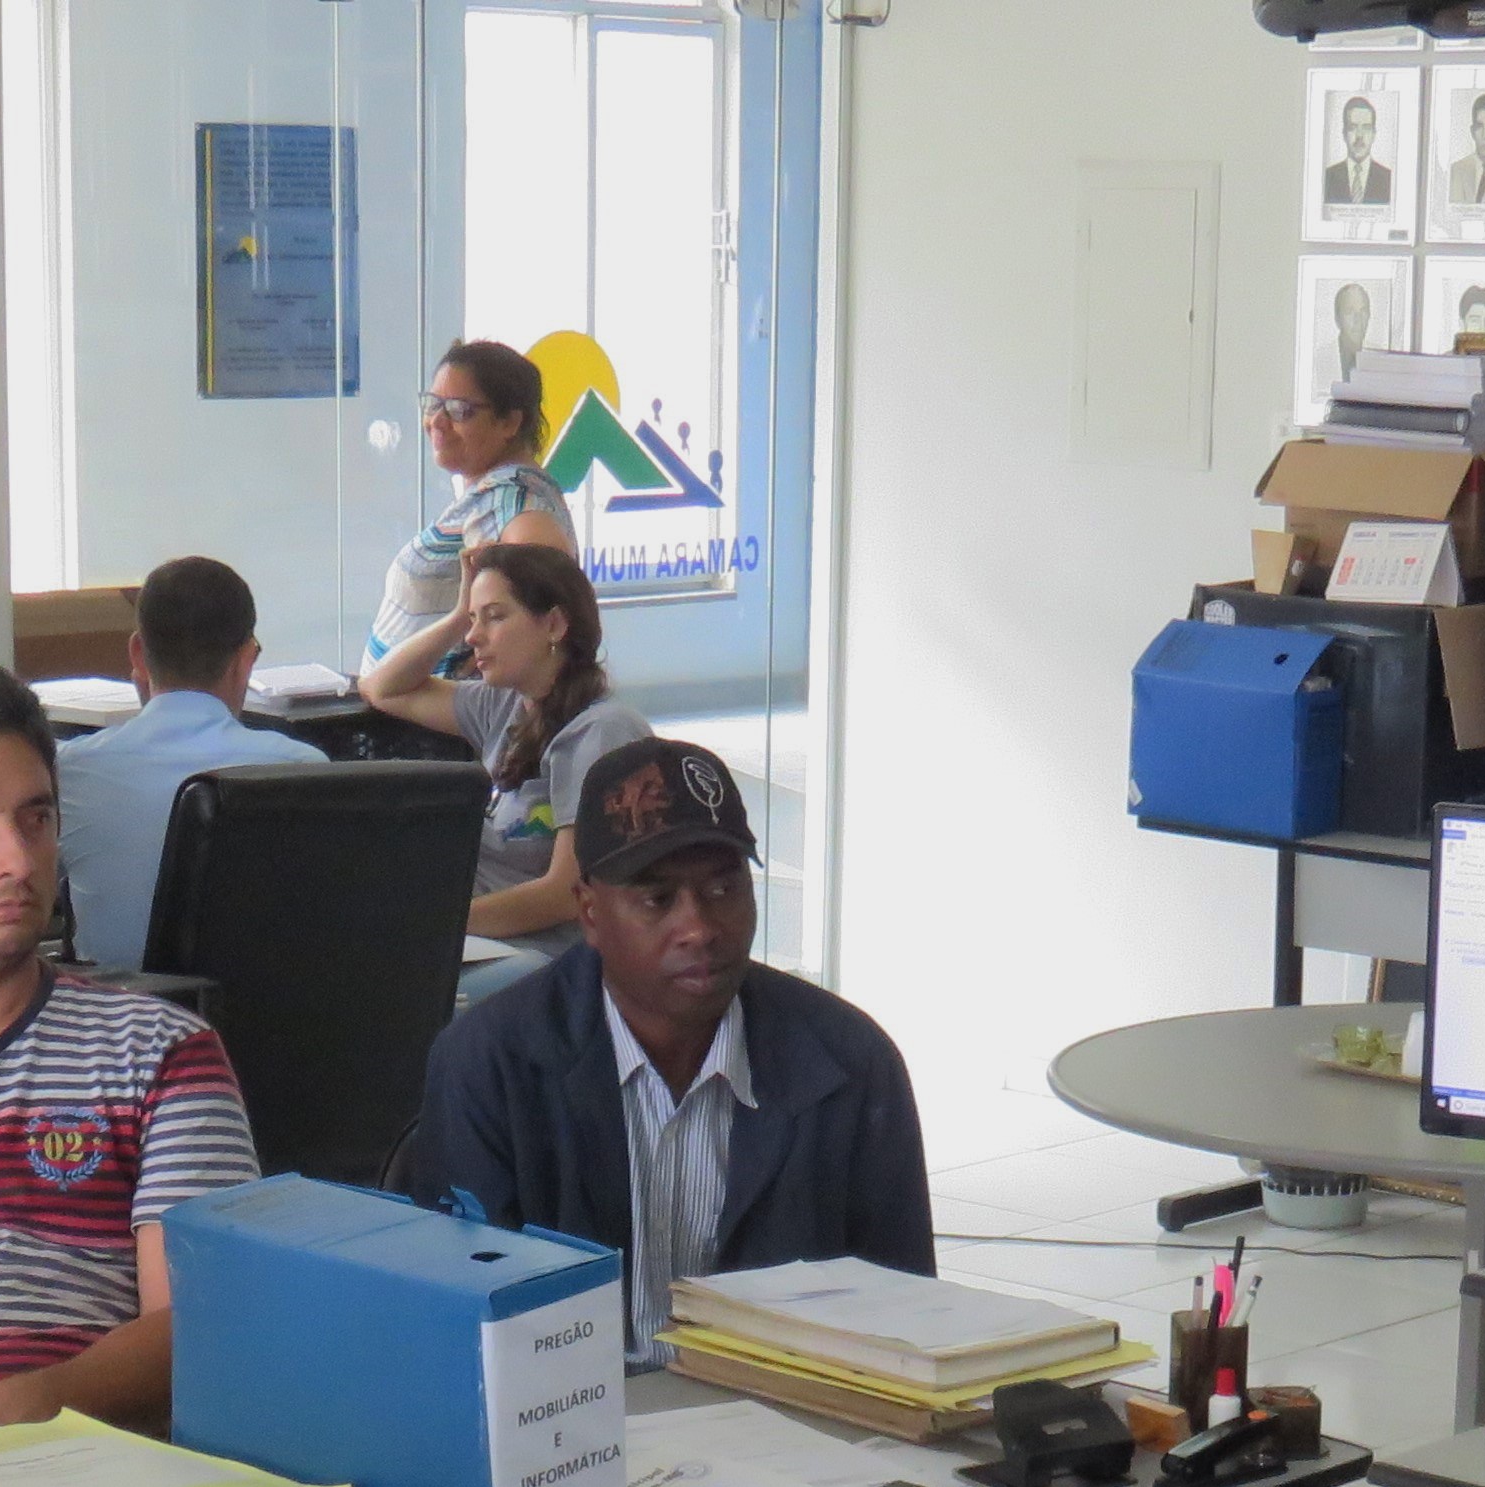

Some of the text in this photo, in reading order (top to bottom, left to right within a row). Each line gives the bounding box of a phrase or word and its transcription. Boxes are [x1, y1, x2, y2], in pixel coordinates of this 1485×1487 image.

[43, 1130, 85, 1162] 02
[534, 1319, 594, 1353] PREGÃO
[517, 1383, 606, 1427] MOBILIÁRIO
[554, 1431, 563, 1448] E
